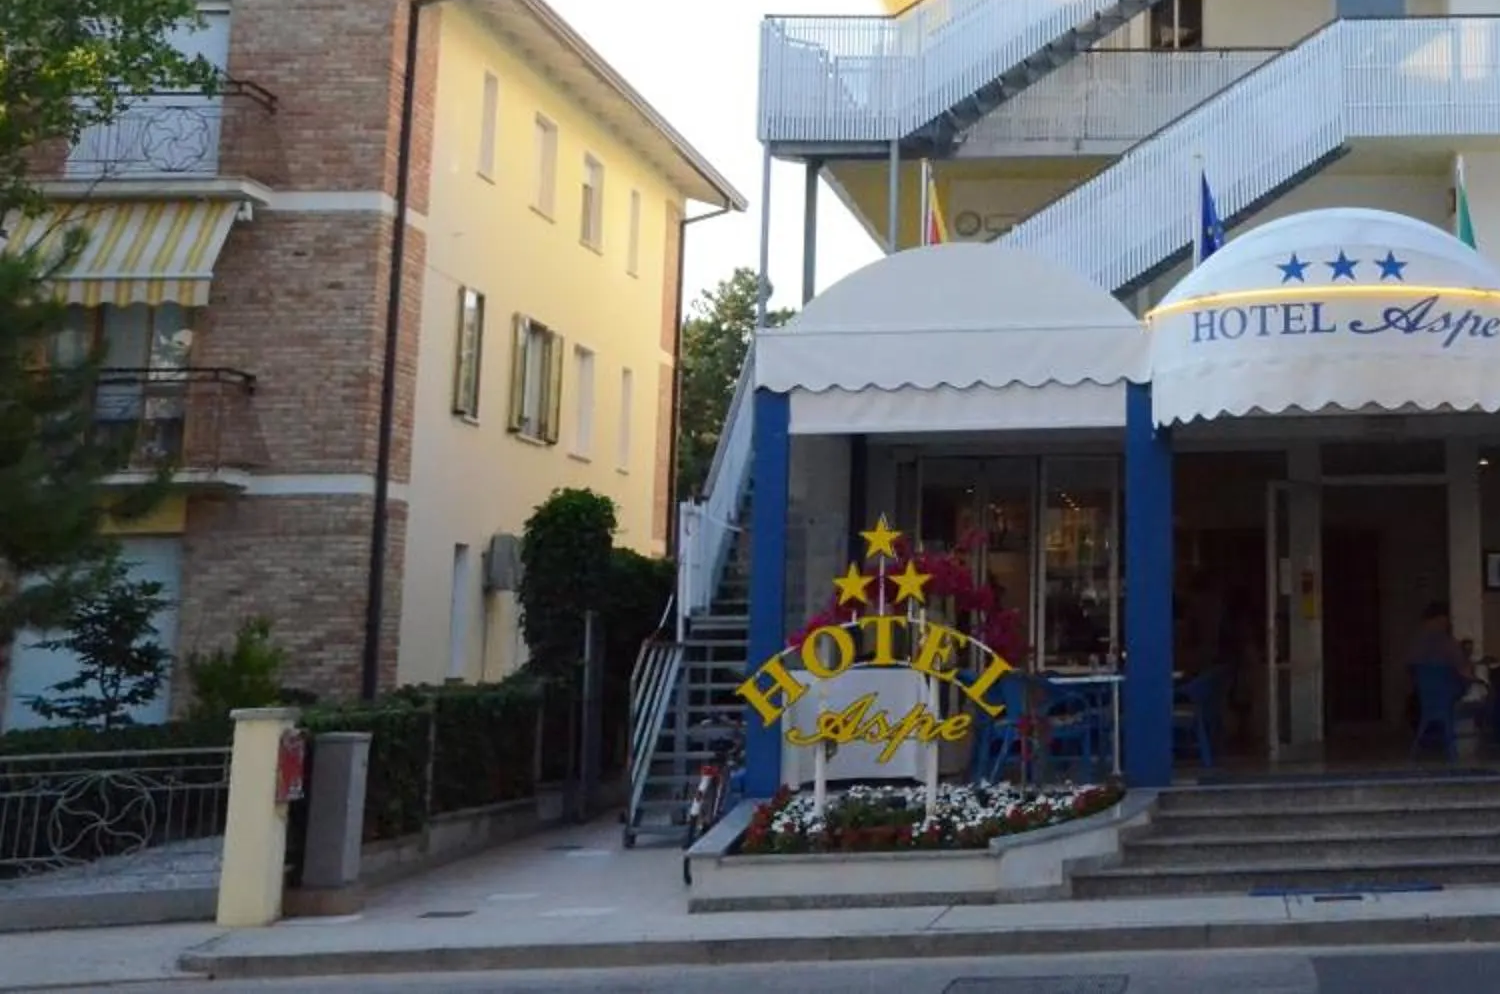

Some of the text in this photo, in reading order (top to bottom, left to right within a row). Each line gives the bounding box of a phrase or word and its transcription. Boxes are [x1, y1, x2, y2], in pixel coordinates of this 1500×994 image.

[1192, 301, 1337, 343] HOTEL
[735, 615, 1013, 728] HOTEL
[785, 692, 972, 764] Aspe
